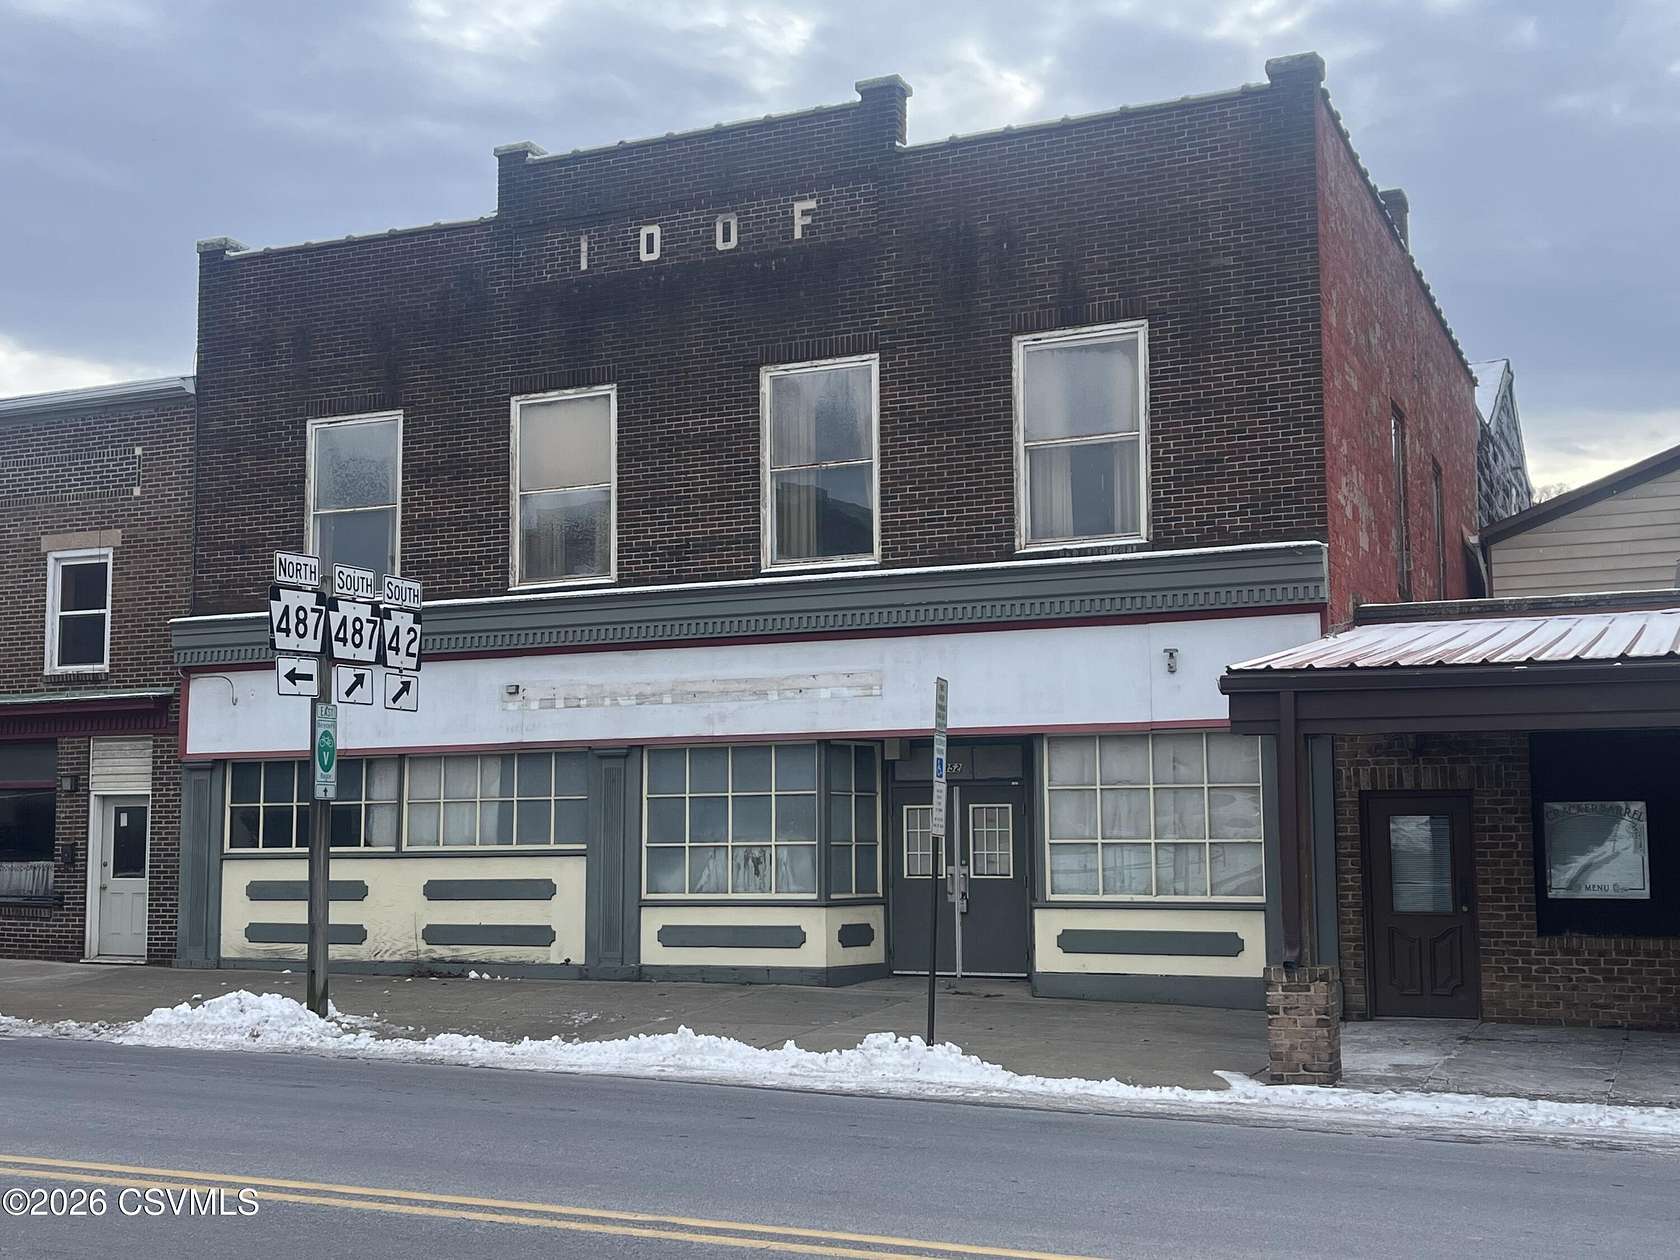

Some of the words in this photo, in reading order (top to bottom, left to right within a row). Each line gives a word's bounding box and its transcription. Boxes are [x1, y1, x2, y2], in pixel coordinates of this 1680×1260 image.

[639, 224, 661, 262] O
[715, 212, 738, 251] O
[793, 199, 817, 240] F
[278, 557, 317, 582] NORTH
[337, 570, 373, 594] SOUTH
[386, 581, 419, 604] SOUTH
[276, 604, 324, 641] 487
[334, 615, 378, 650] 487
[387, 625, 418, 658] 42
[320, 706, 334, 717] EAST
[322, 751, 330, 766] V
[1584, 884, 1610, 892] MENU
